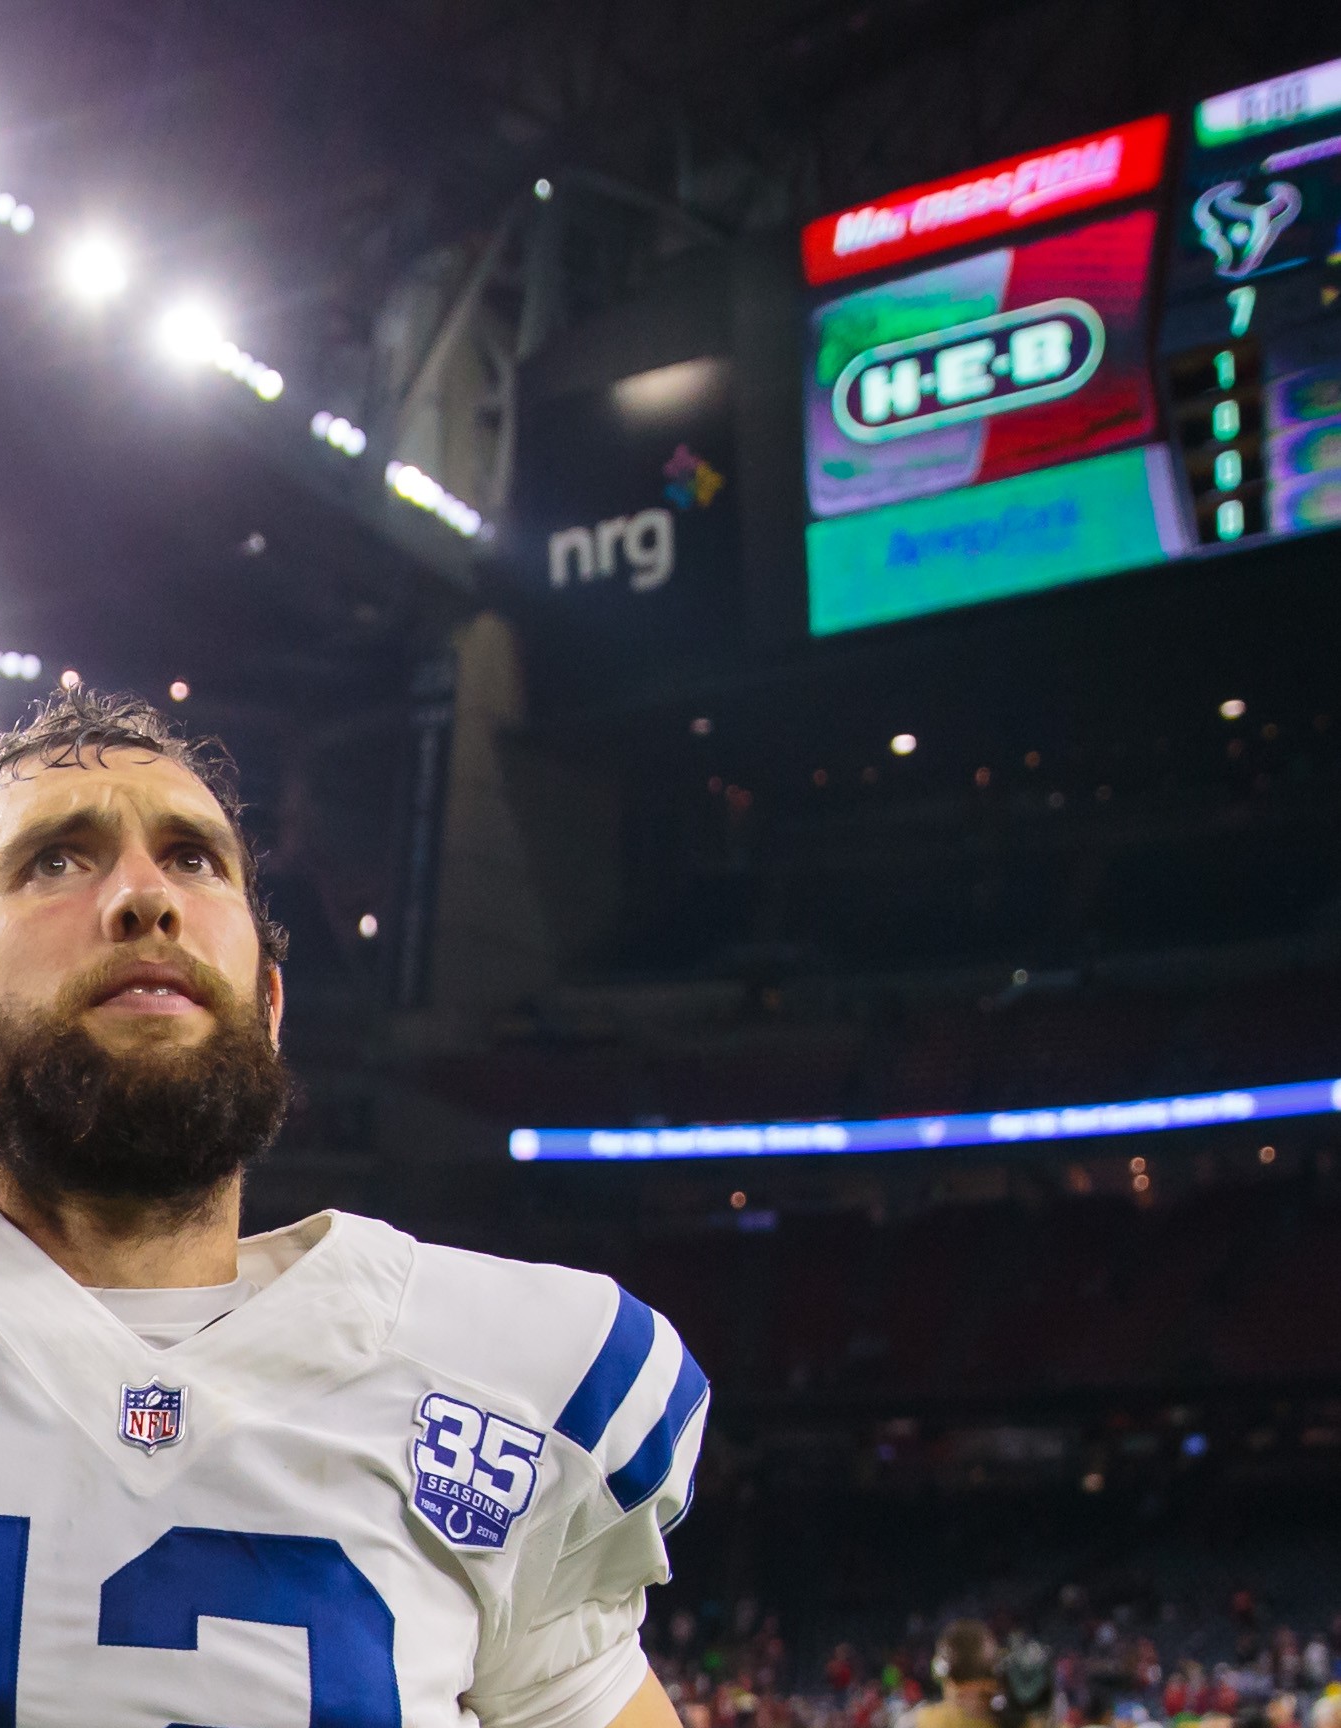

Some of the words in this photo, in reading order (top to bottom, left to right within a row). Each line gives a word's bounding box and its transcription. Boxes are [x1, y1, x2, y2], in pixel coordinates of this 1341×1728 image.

[548, 508, 674, 592] nrg
[128, 1410, 174, 1441] NFL
[416, 1397, 542, 1514] 35
[420, 1498, 442, 1516] 1984
[427, 1475, 505, 1521] SEASONS
[476, 1525, 499, 1543] 2018
